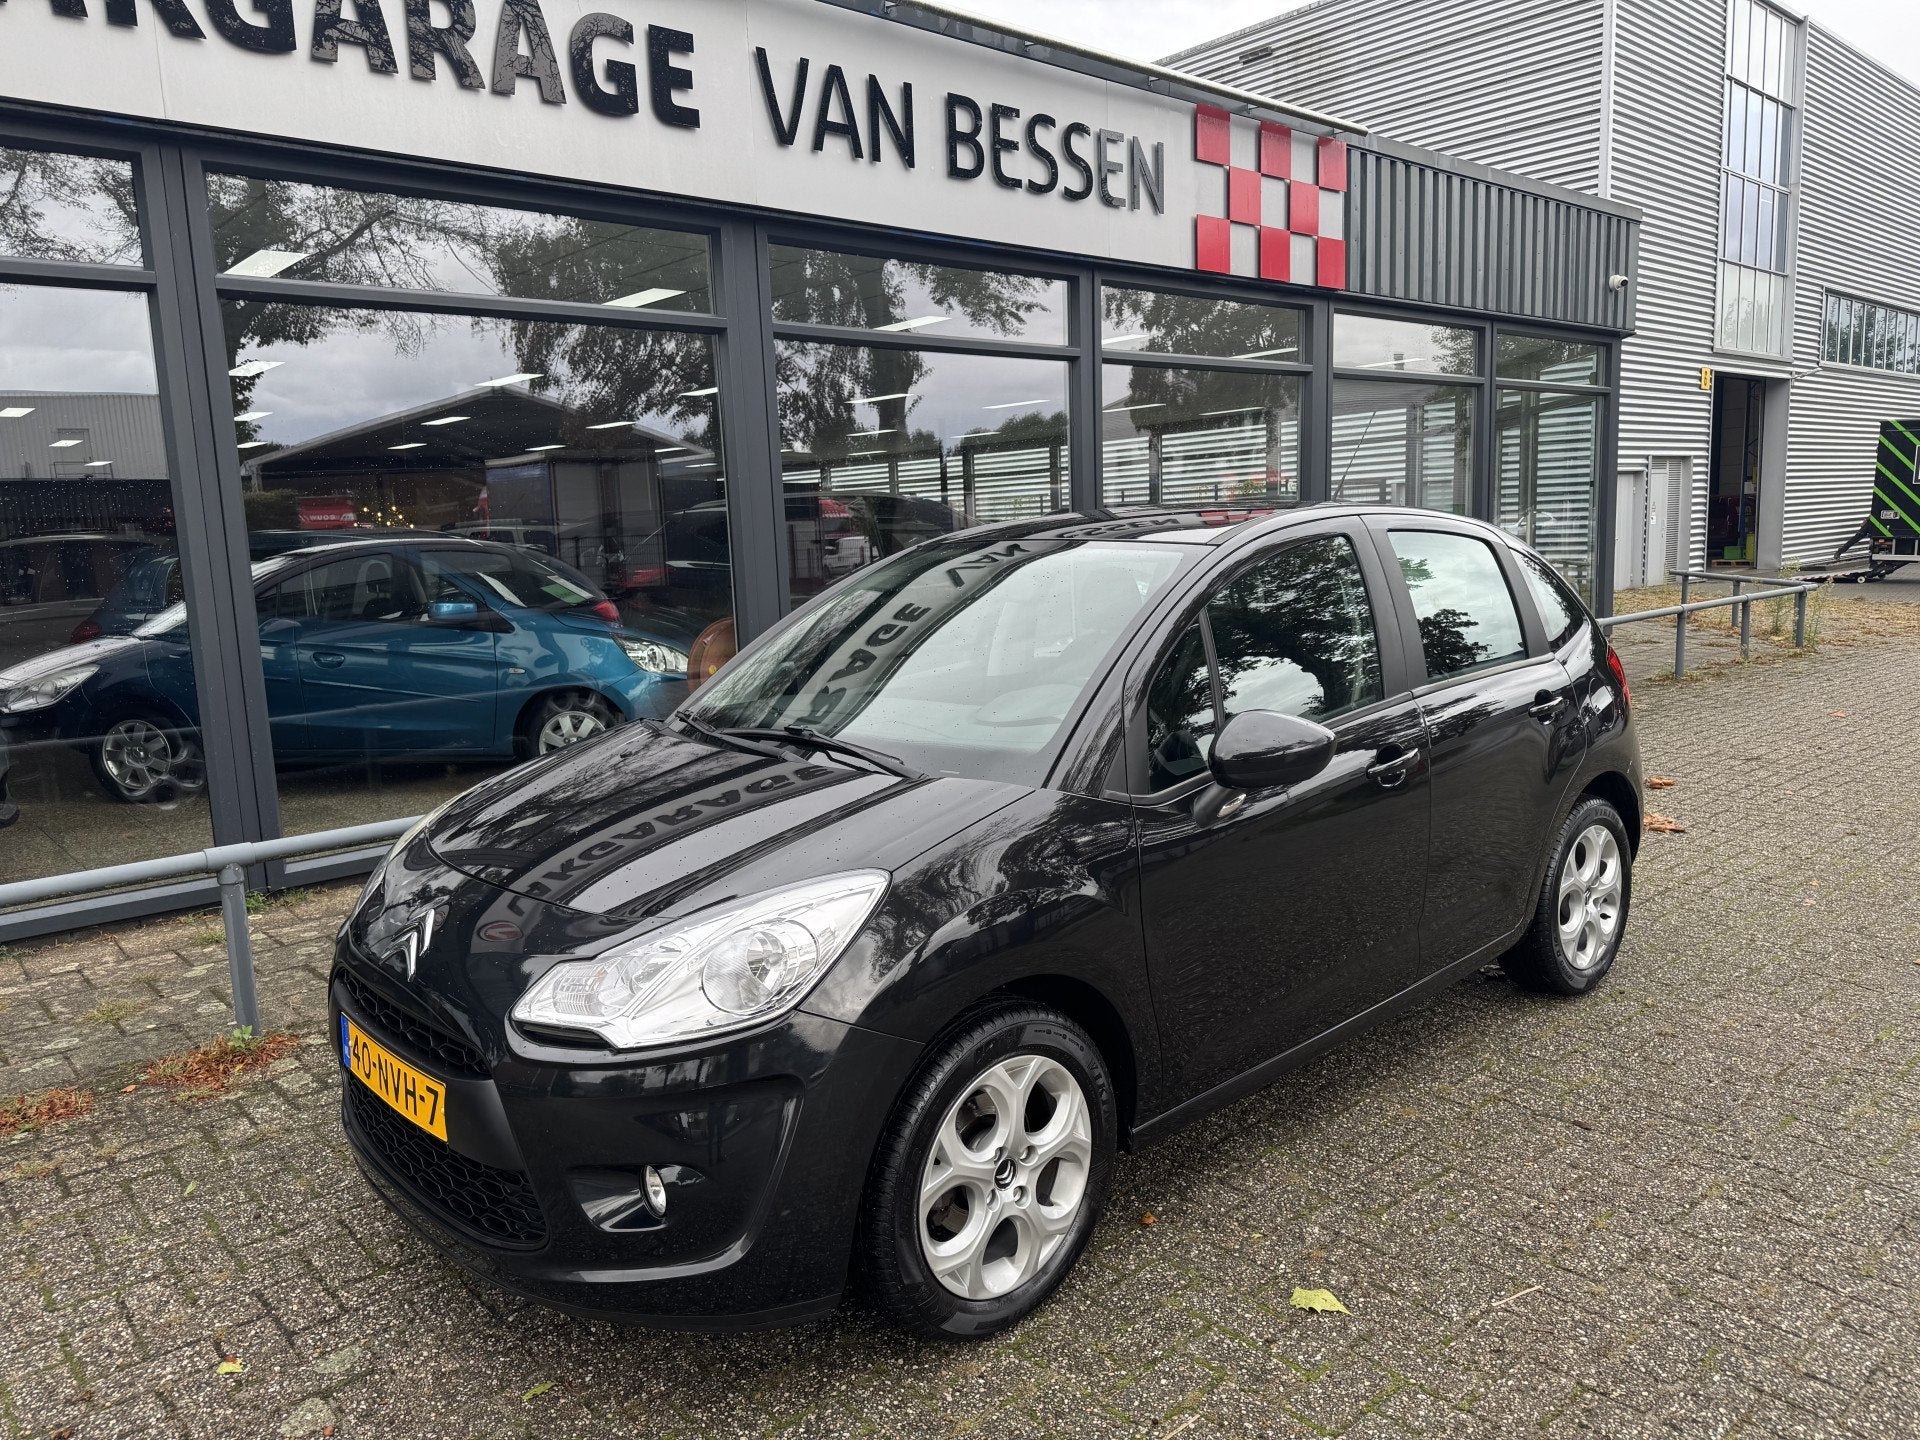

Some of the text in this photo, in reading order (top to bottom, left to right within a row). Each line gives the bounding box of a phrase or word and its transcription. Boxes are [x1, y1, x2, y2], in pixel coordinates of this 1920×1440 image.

[0, 0, 1165, 215] GARAGE VAN BESSEN
[352, 1034, 438, 1126] 40-NVH-7
